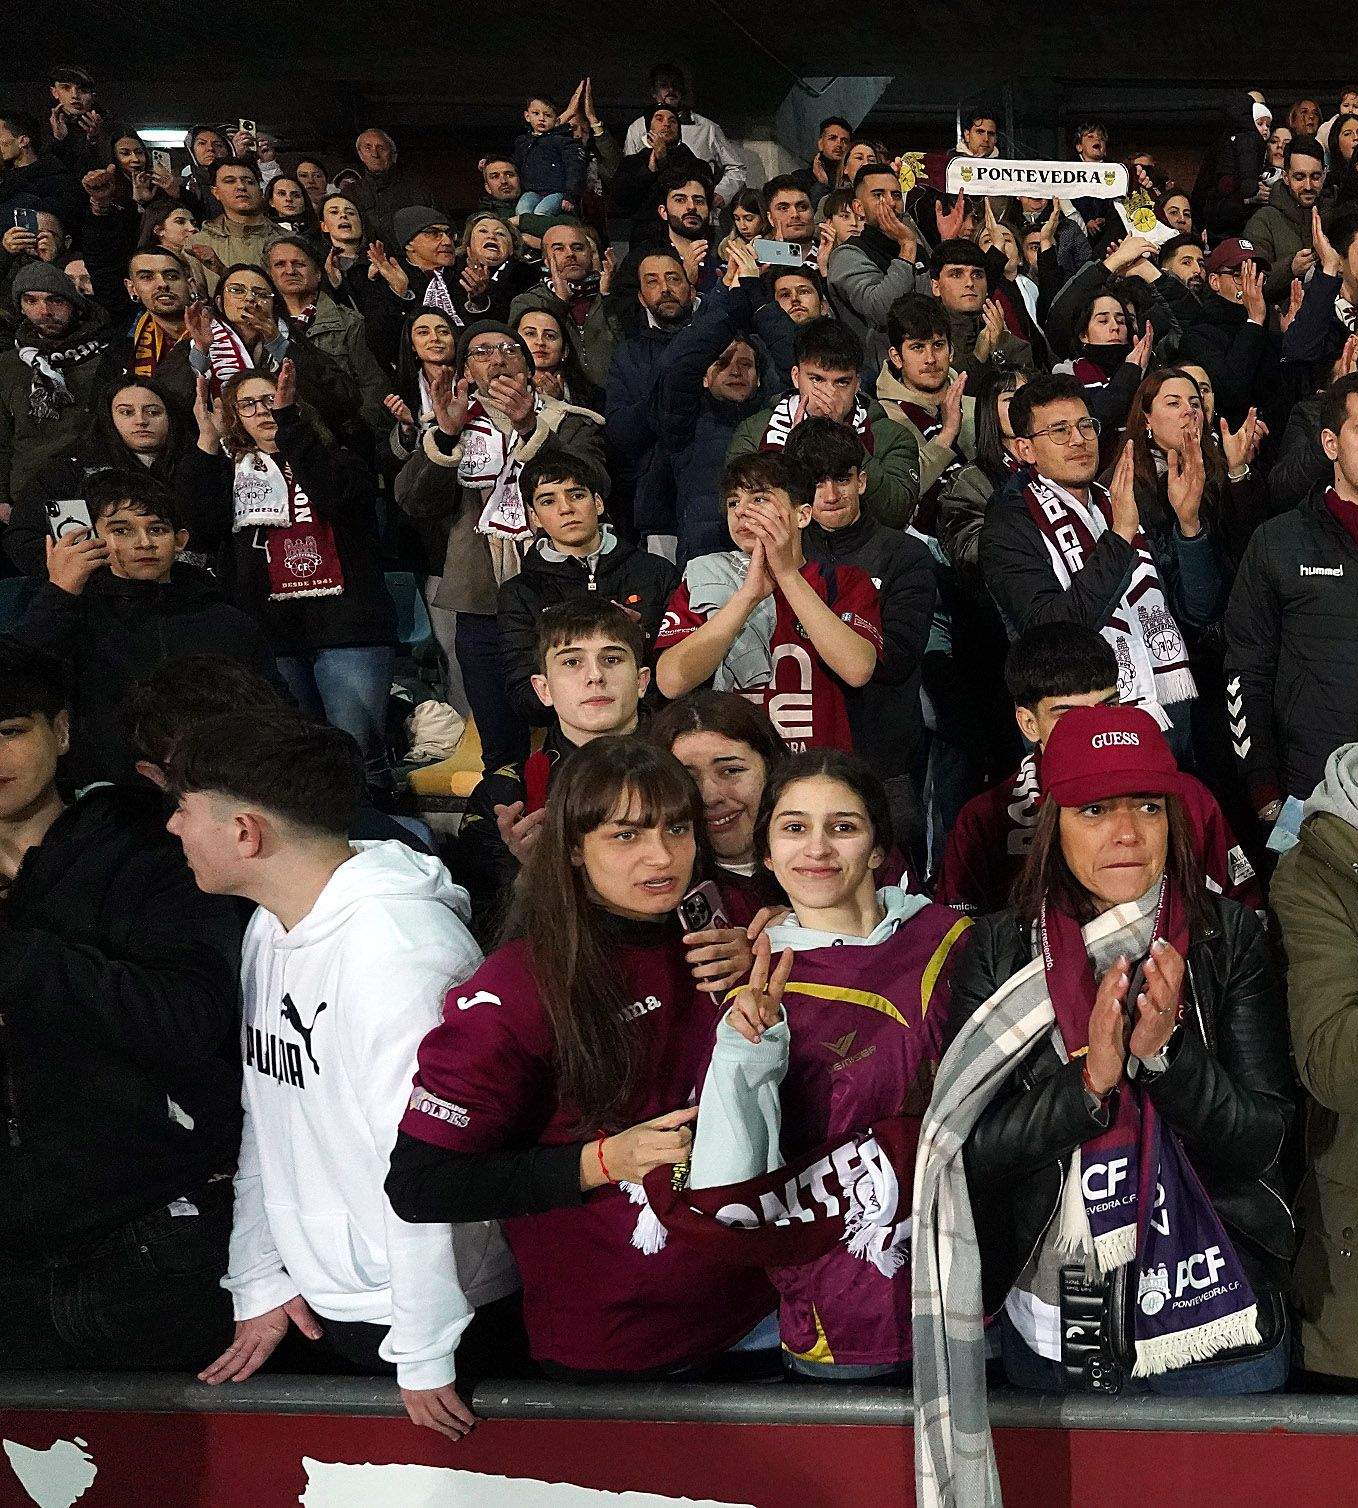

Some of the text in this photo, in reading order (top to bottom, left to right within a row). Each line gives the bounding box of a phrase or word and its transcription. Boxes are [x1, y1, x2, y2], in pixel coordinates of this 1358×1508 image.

[976, 167, 1102, 184] PONTEVEDRA
[1299, 564, 1343, 577] hummel
[1091, 731, 1140, 749] GUESS
[246, 1023, 305, 1090] PUMA
[1081, 1157, 1128, 1201] CF
[1174, 1245, 1226, 1298] PCF
[1172, 1287, 1227, 1310] PONTEVEDRA
